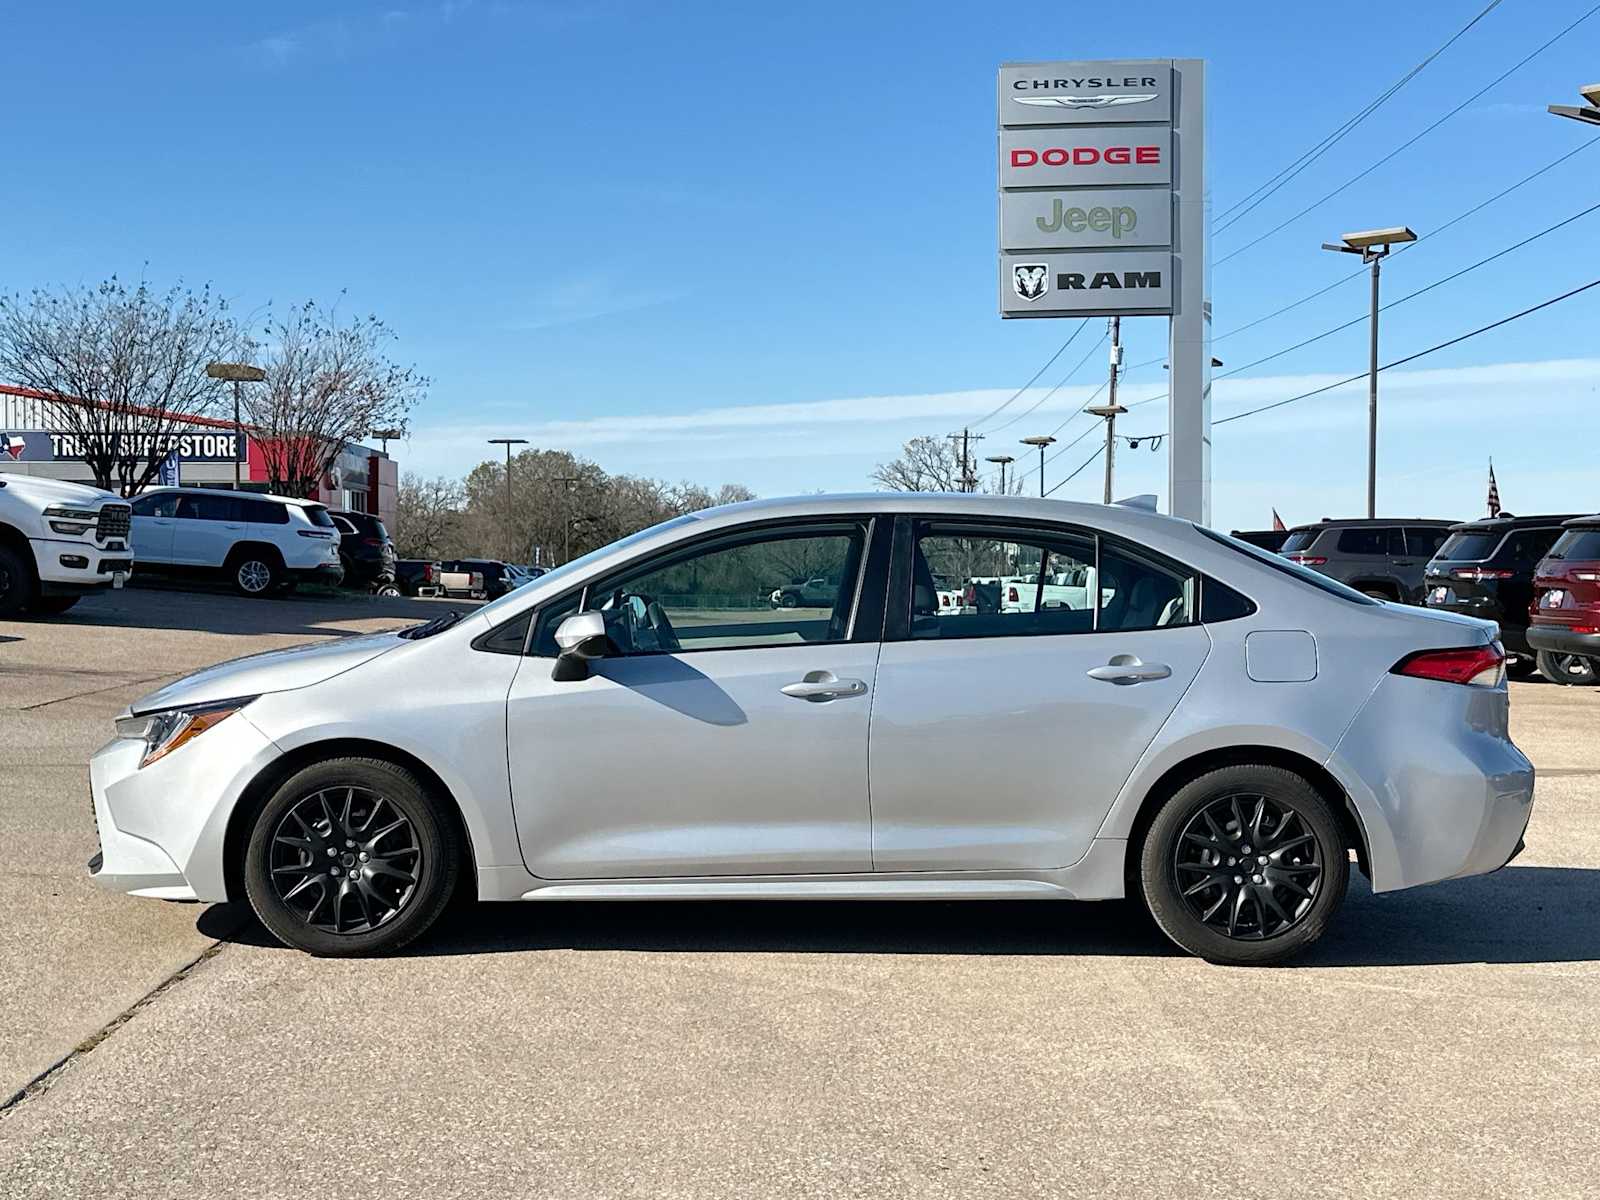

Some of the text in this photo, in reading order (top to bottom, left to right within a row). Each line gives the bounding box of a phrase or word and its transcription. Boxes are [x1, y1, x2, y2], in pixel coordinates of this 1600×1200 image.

[1013, 77, 1157, 90] CHRYSLER
[1011, 147, 1160, 167] DODGE
[1036, 199, 1137, 239] Jeep
[1057, 271, 1161, 290] RAM
